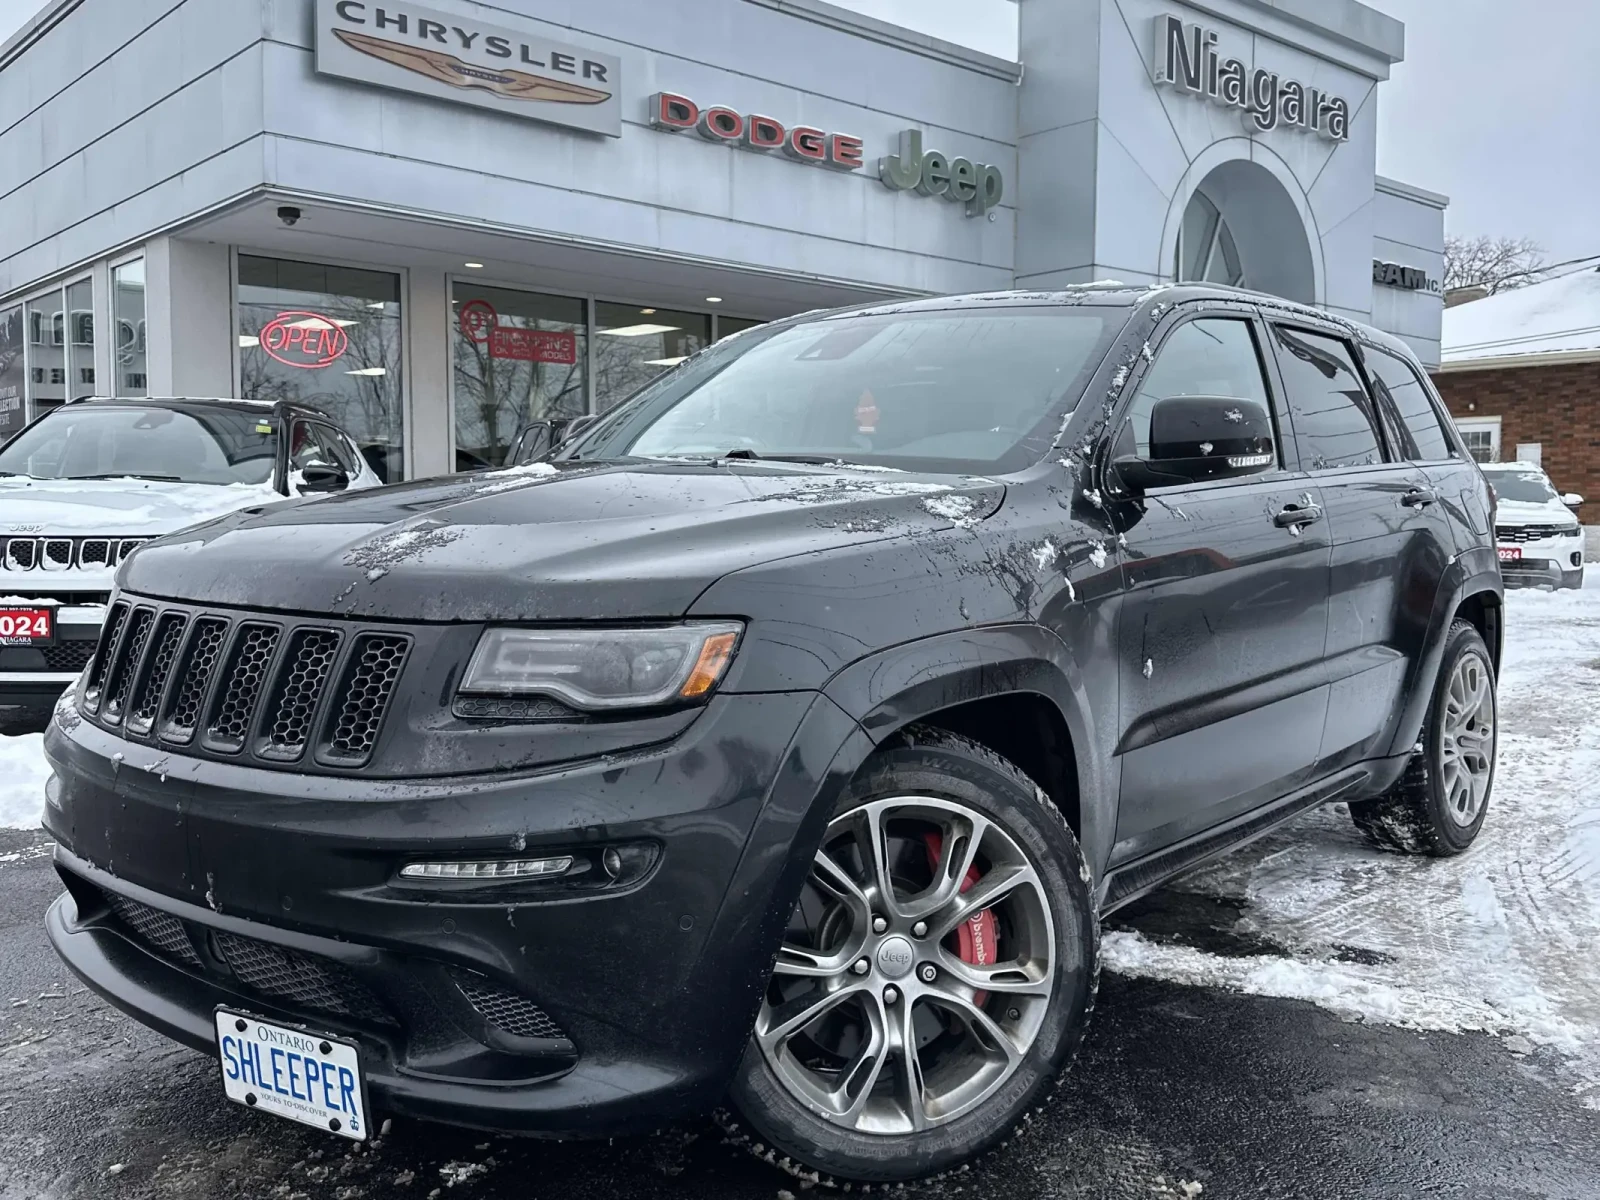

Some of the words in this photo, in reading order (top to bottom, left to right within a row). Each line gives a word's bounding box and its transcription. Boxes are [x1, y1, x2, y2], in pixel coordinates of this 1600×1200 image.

[336, 1, 609, 83] CHRYSLER
[1154, 14, 1349, 143] Niagara
[650, 92, 864, 170] DODGE
[879, 129, 1003, 218] Jeep
[1372, 258, 1425, 290] RAM
[1425, 278, 1441, 293] NC.
[266, 324, 340, 356] OPEN
[9, 524, 43, 533] Jeep
[1498, 550, 1520, 559] 024
[0, 616, 48, 636] 024
[881, 950, 910, 965] Jeep
[257, 1026, 314, 1053] ONTARIO
[222, 1035, 358, 1117] SHLEEPER
[261, 1092, 281, 1104] YOURS
[294, 1103, 328, 1117] DISCOVER
